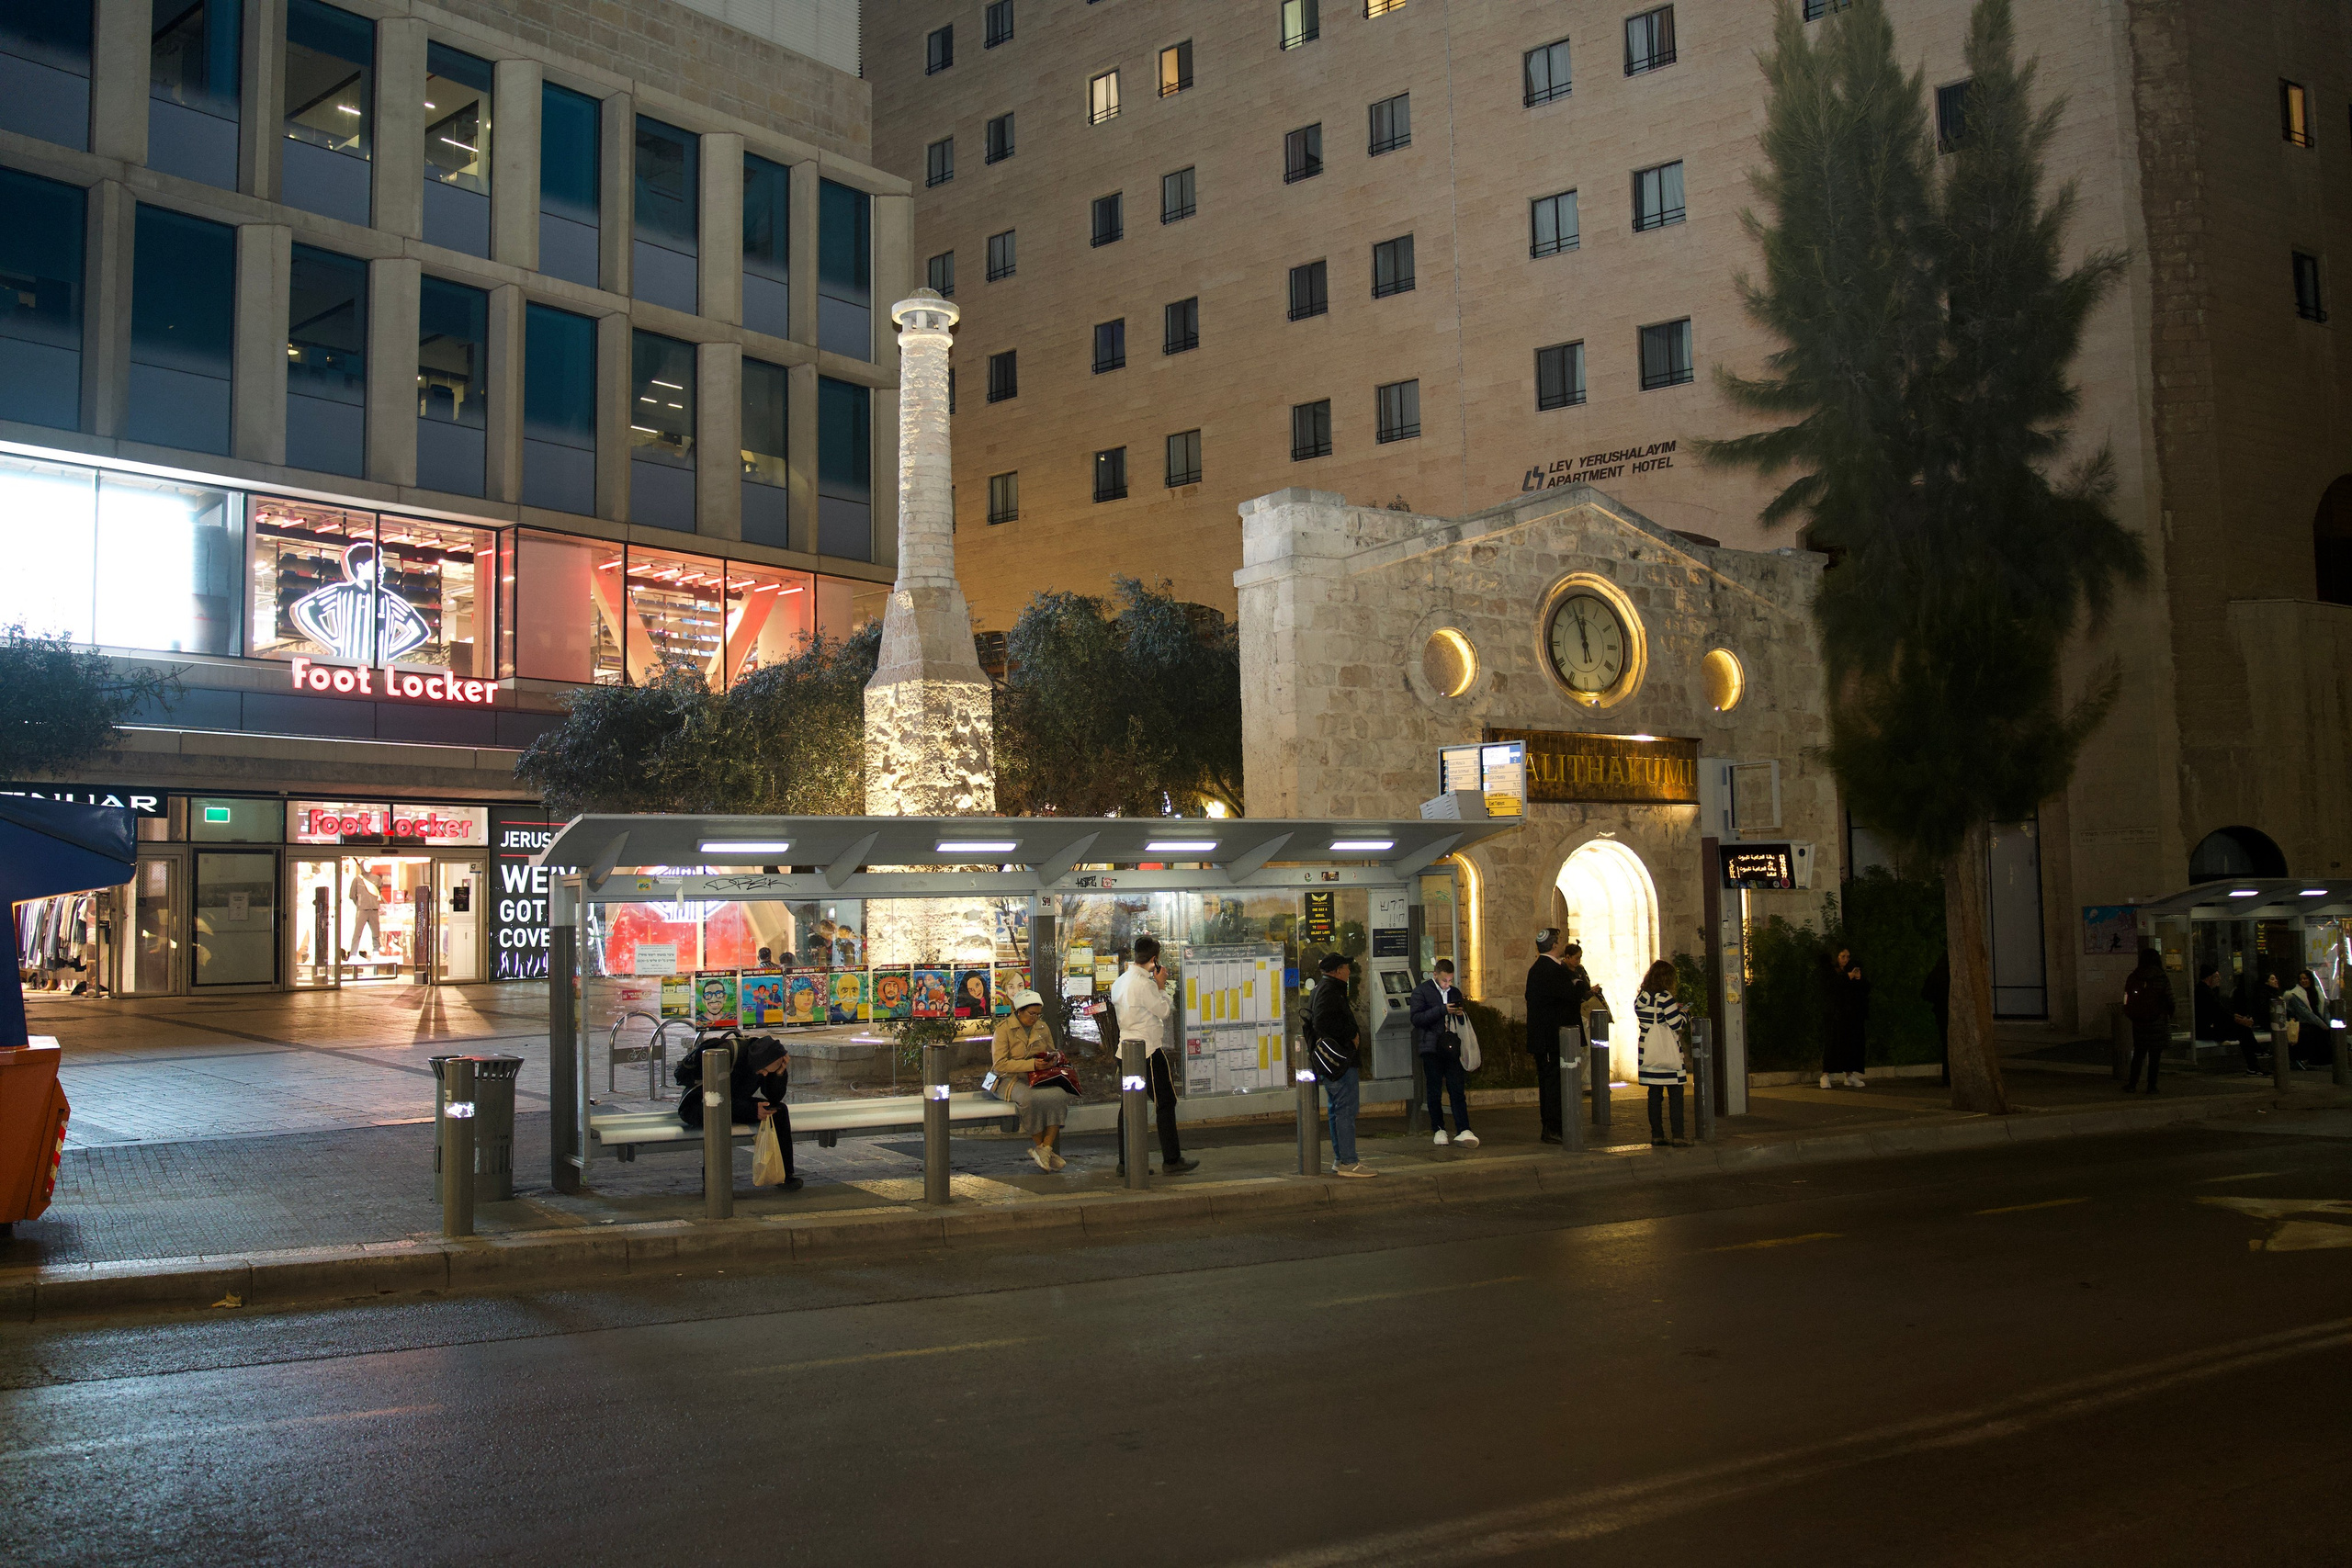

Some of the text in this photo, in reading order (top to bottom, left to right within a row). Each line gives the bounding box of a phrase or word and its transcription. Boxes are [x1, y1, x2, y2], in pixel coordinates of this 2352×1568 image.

[1549, 440, 1676, 473] LEV YERUSHALAYIM
[1547, 457, 1674, 489] APARTMENT HOTEL
[292, 657, 499, 705] Foot Locker
[1525, 751, 1695, 787] ALITHAKUMI
[309, 808, 473, 840] Foot Locker
[500, 829, 559, 849] JERUS
[499, 899, 547, 922] GOT
